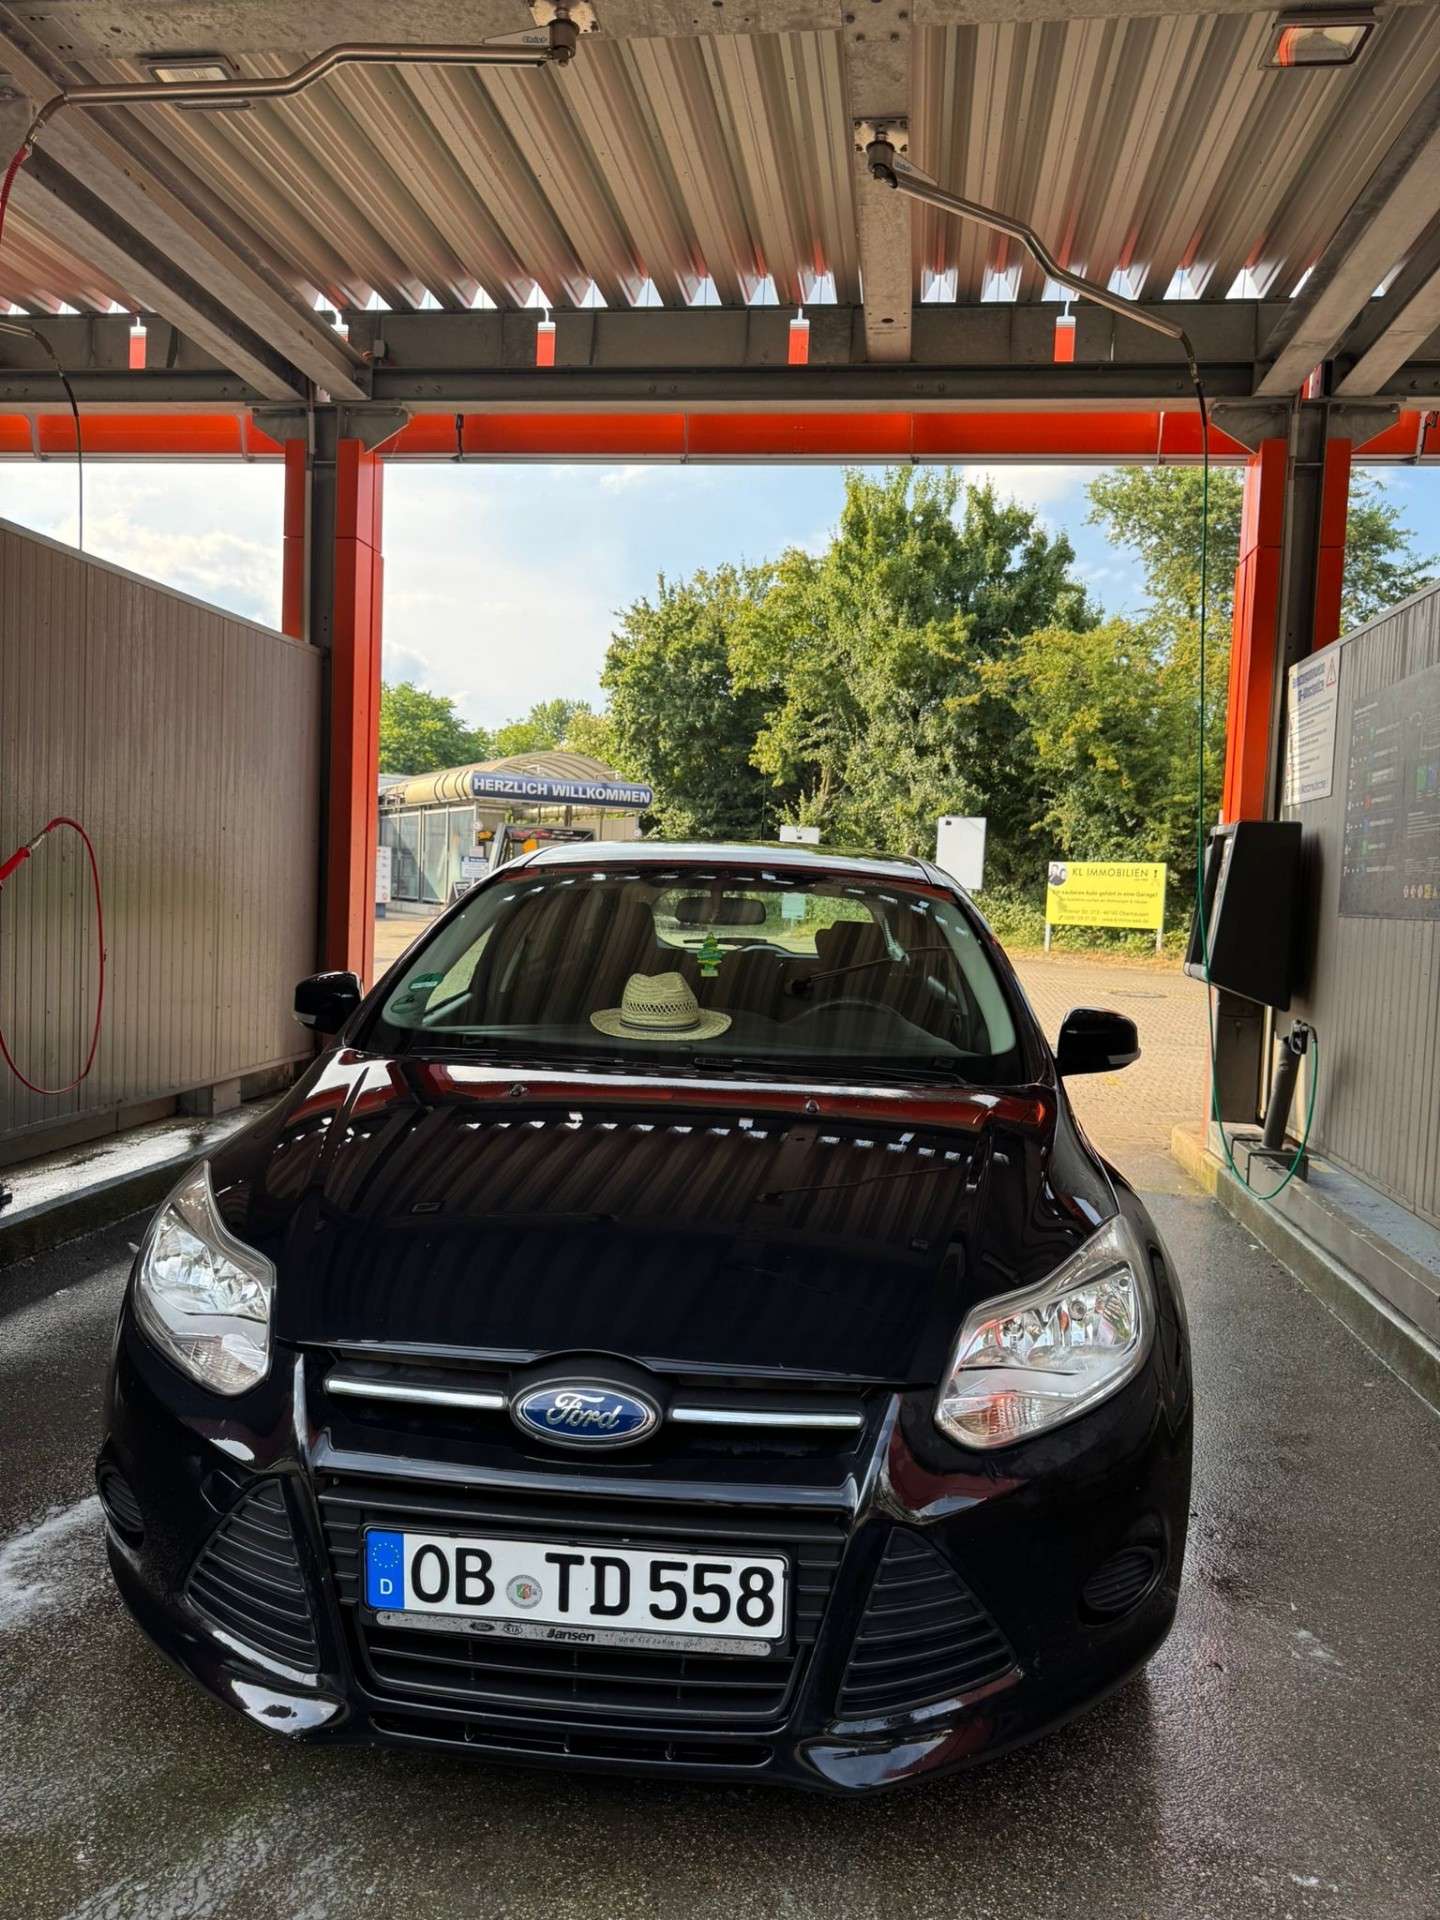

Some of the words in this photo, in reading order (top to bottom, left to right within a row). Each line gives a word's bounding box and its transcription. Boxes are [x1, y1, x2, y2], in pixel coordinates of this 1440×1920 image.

[473, 778, 548, 795] HERZLICH
[552, 785, 651, 803] WILLKOMMEN
[1087, 868, 1149, 878] IMMOBILIEN
[546, 1392, 623, 1430] Ford
[379, 1578, 393, 1595] D
[411, 1544, 495, 1607] OB
[545, 1551, 631, 1617] TD
[648, 1559, 775, 1628] 558
[546, 1628, 596, 1642] Jansen
